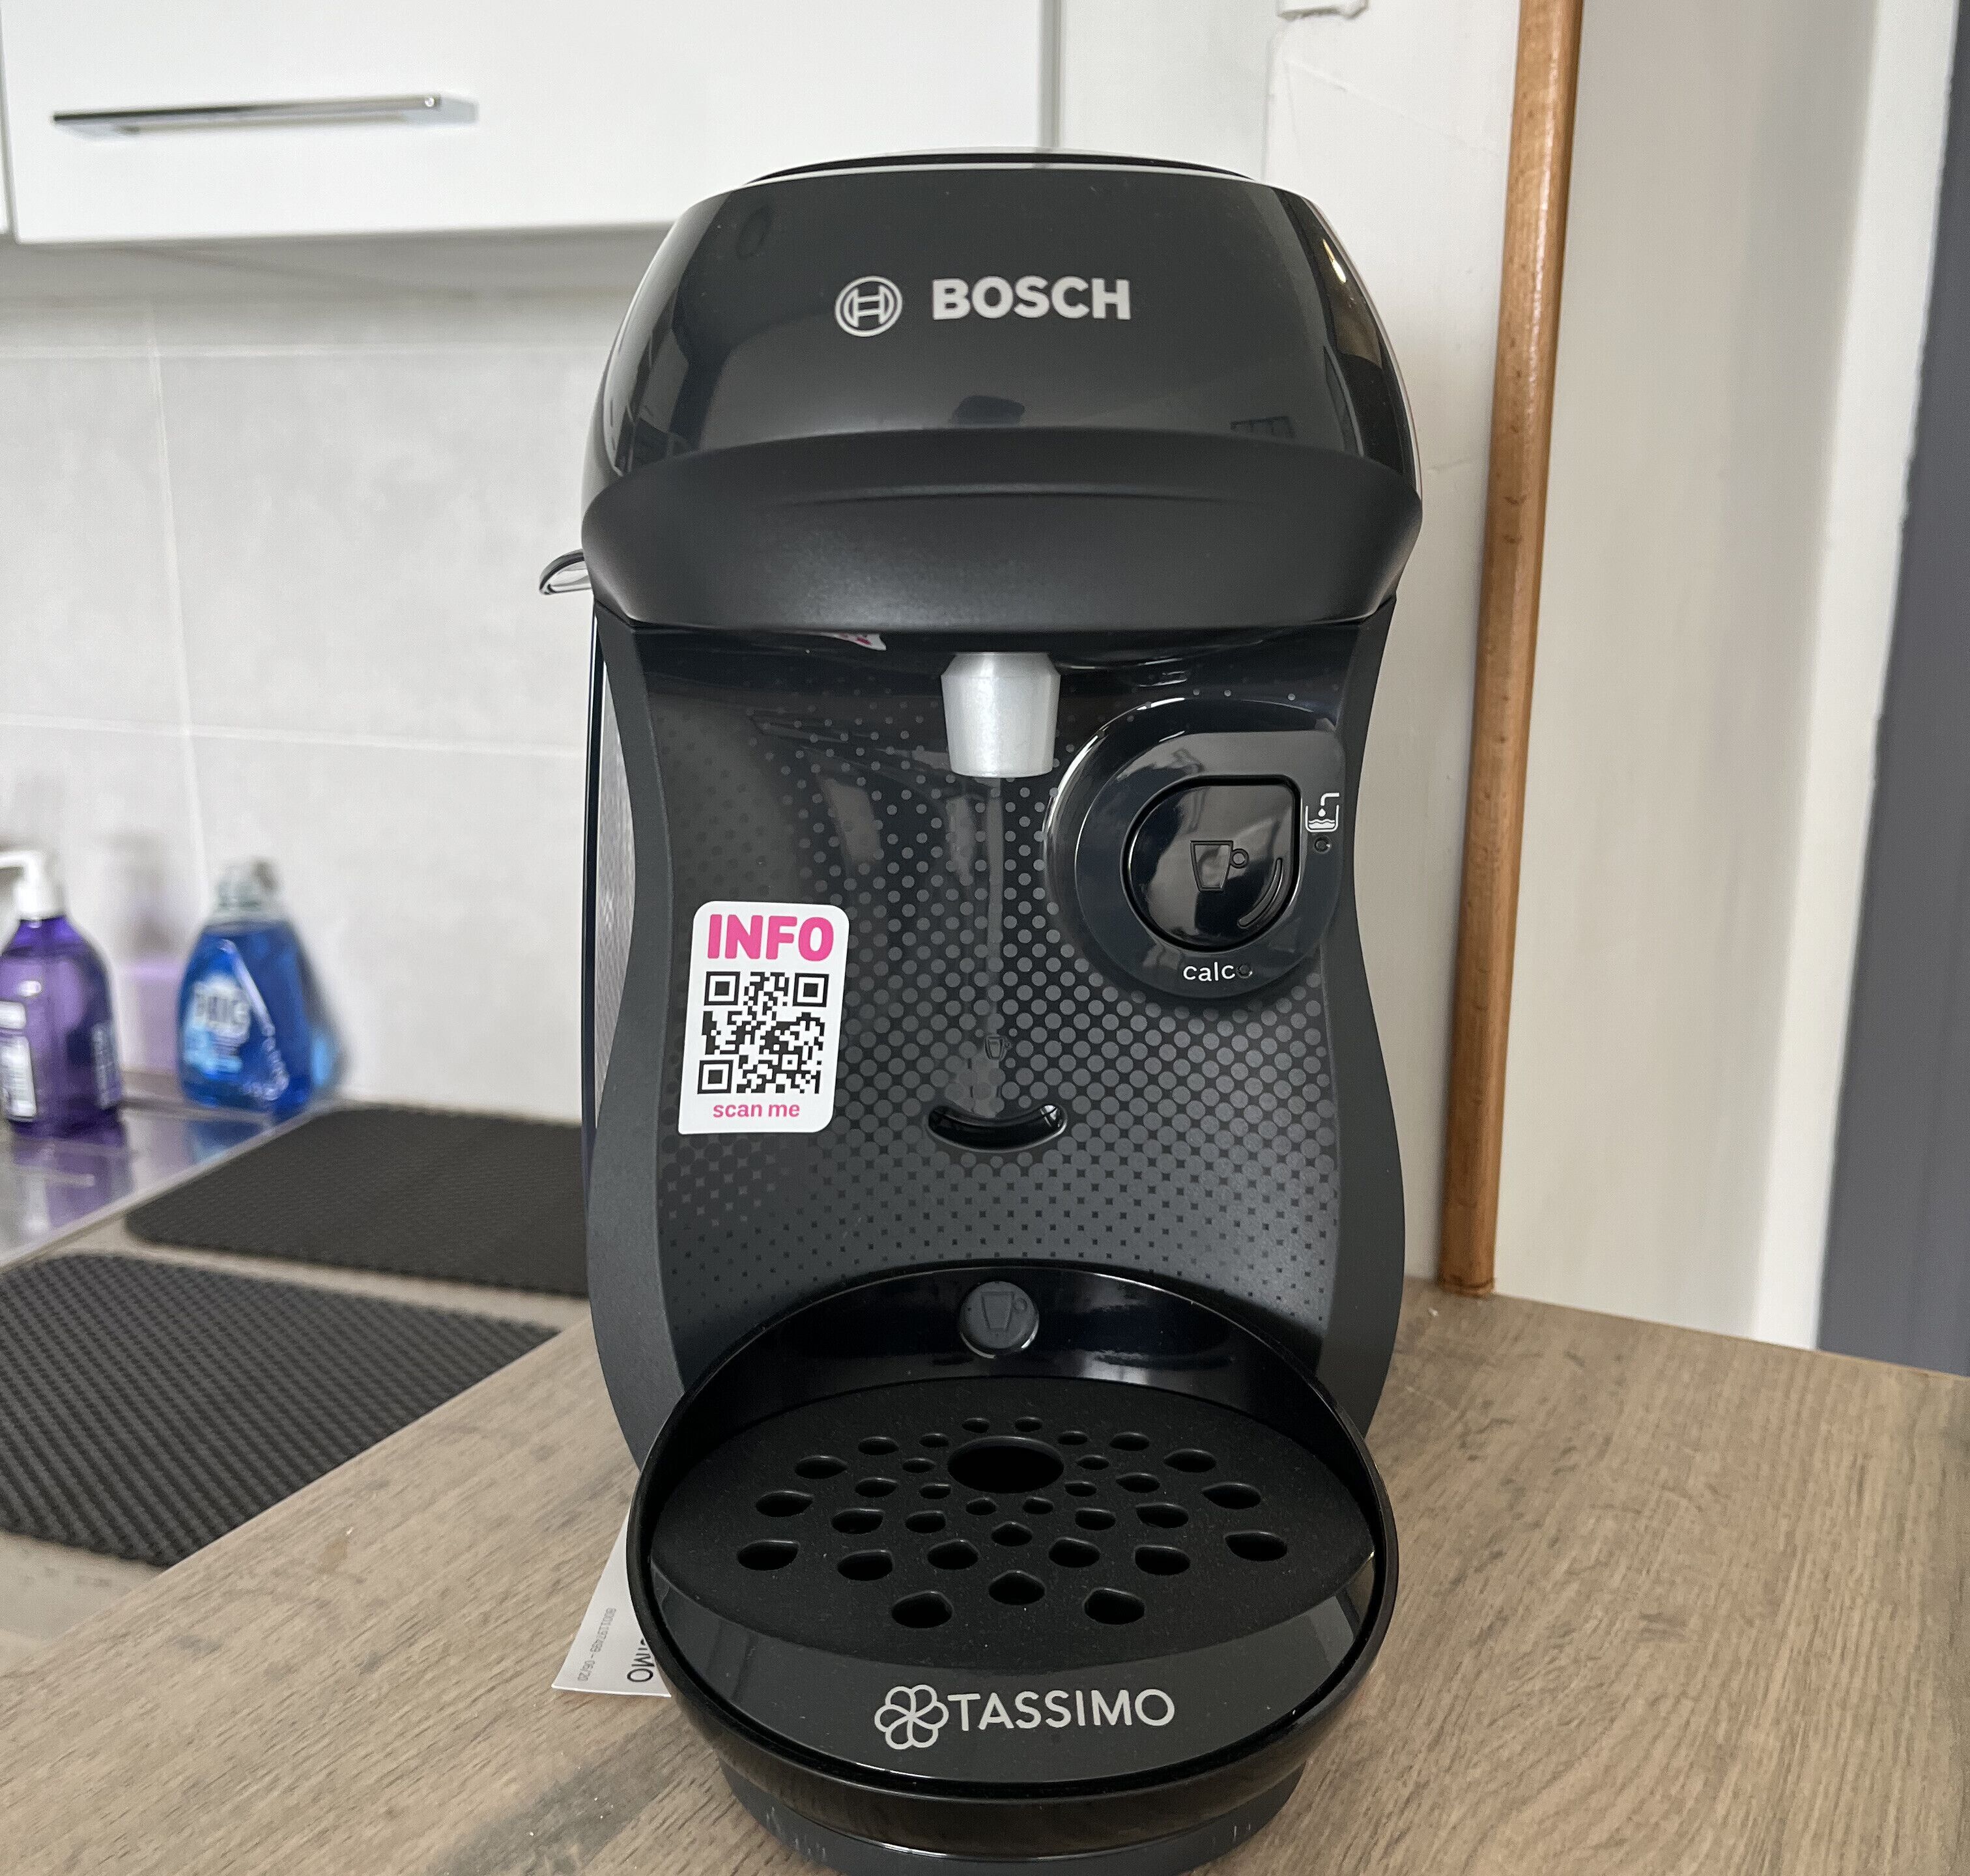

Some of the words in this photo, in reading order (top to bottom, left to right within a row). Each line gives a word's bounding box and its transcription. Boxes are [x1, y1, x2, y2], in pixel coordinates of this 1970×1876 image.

[932, 276, 1131, 320] BOSCH
[707, 914, 834, 961] INFO
[1182, 961, 1236, 982] calc
[713, 1103, 763, 1118] scan
[768, 1103, 800, 1118] me
[627, 1638, 655, 1683] IMO
[947, 1688, 1175, 1731] TASSIMO
